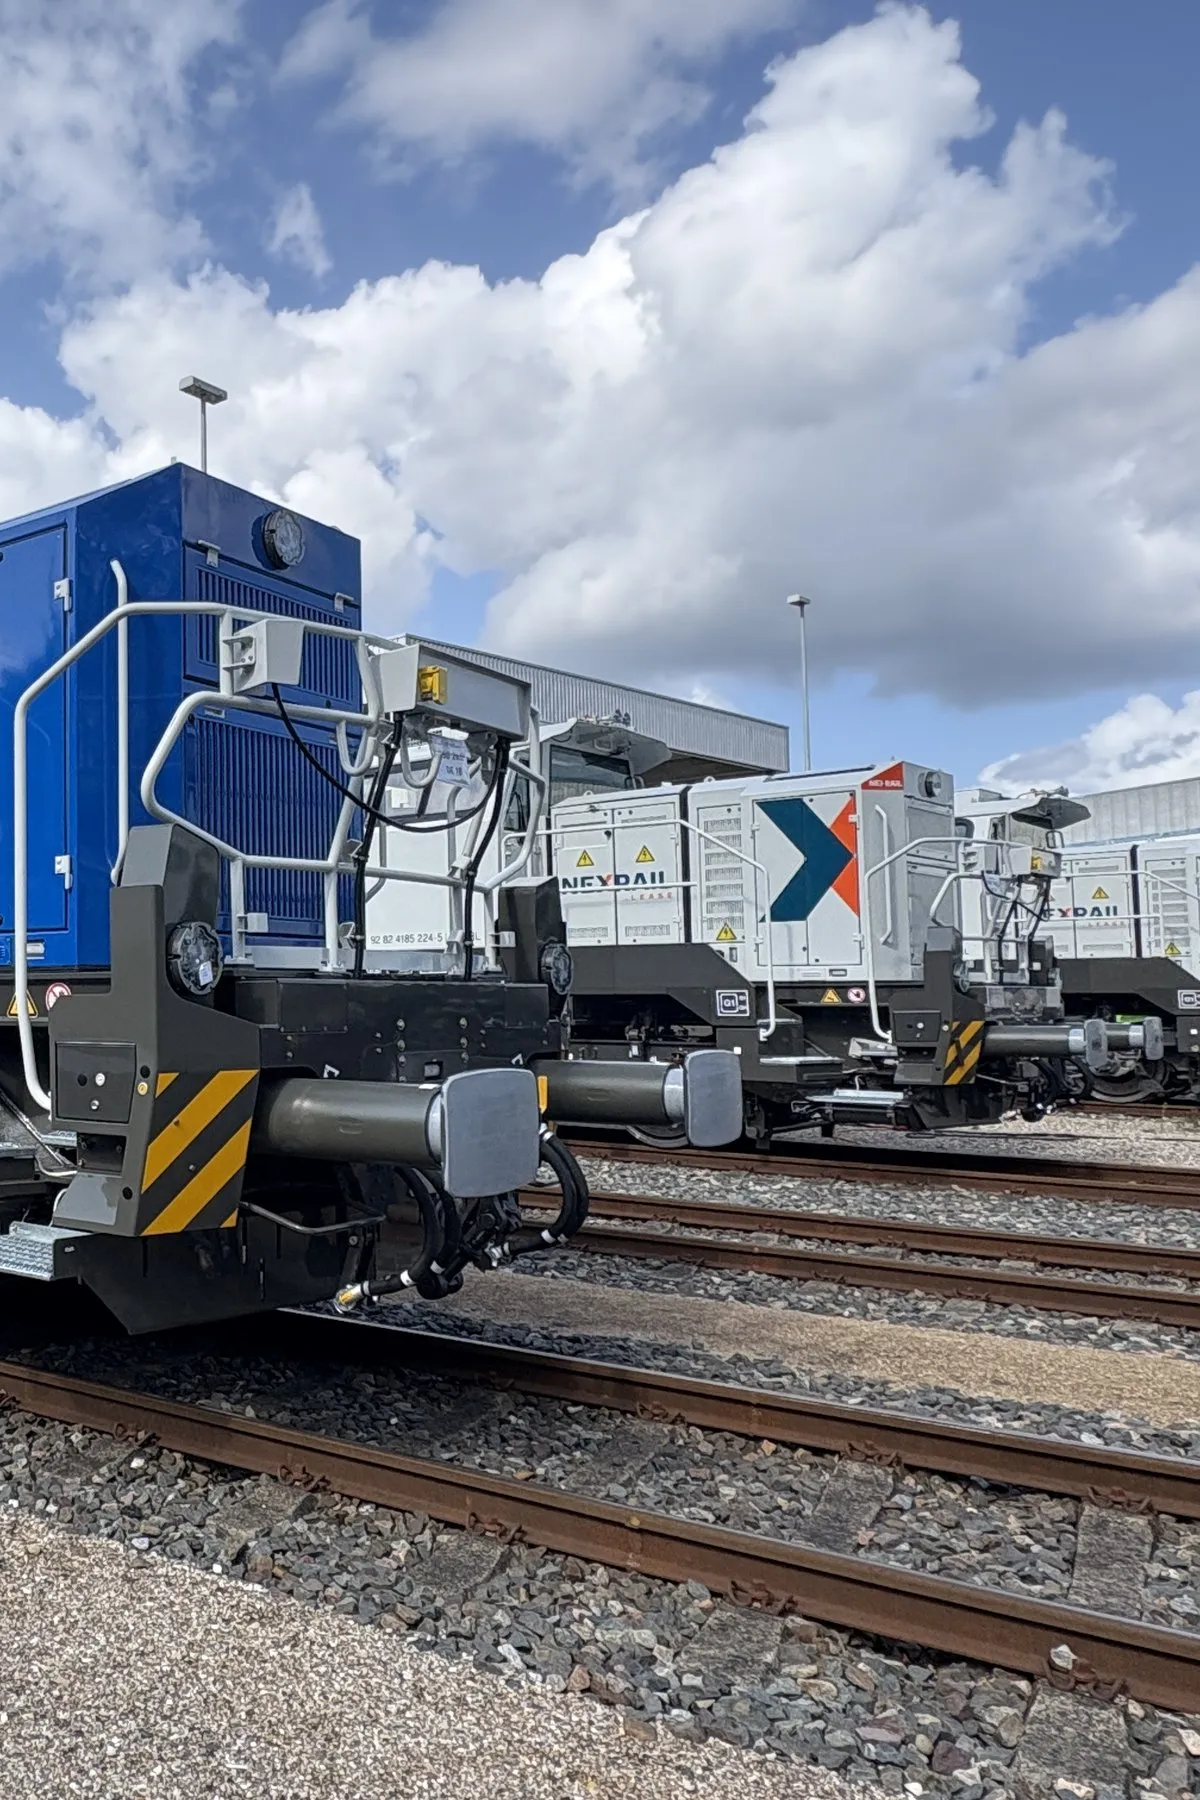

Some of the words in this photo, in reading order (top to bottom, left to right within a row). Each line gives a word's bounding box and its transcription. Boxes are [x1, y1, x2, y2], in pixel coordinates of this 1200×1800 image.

[631, 892, 674, 901] LEASE
[370, 935, 381, 945] 92
[382, 934, 394, 944] 82
[395, 933, 416, 944] 4185
[417, 932, 444, 943] 224-5
[723, 998, 736, 1007] G1
